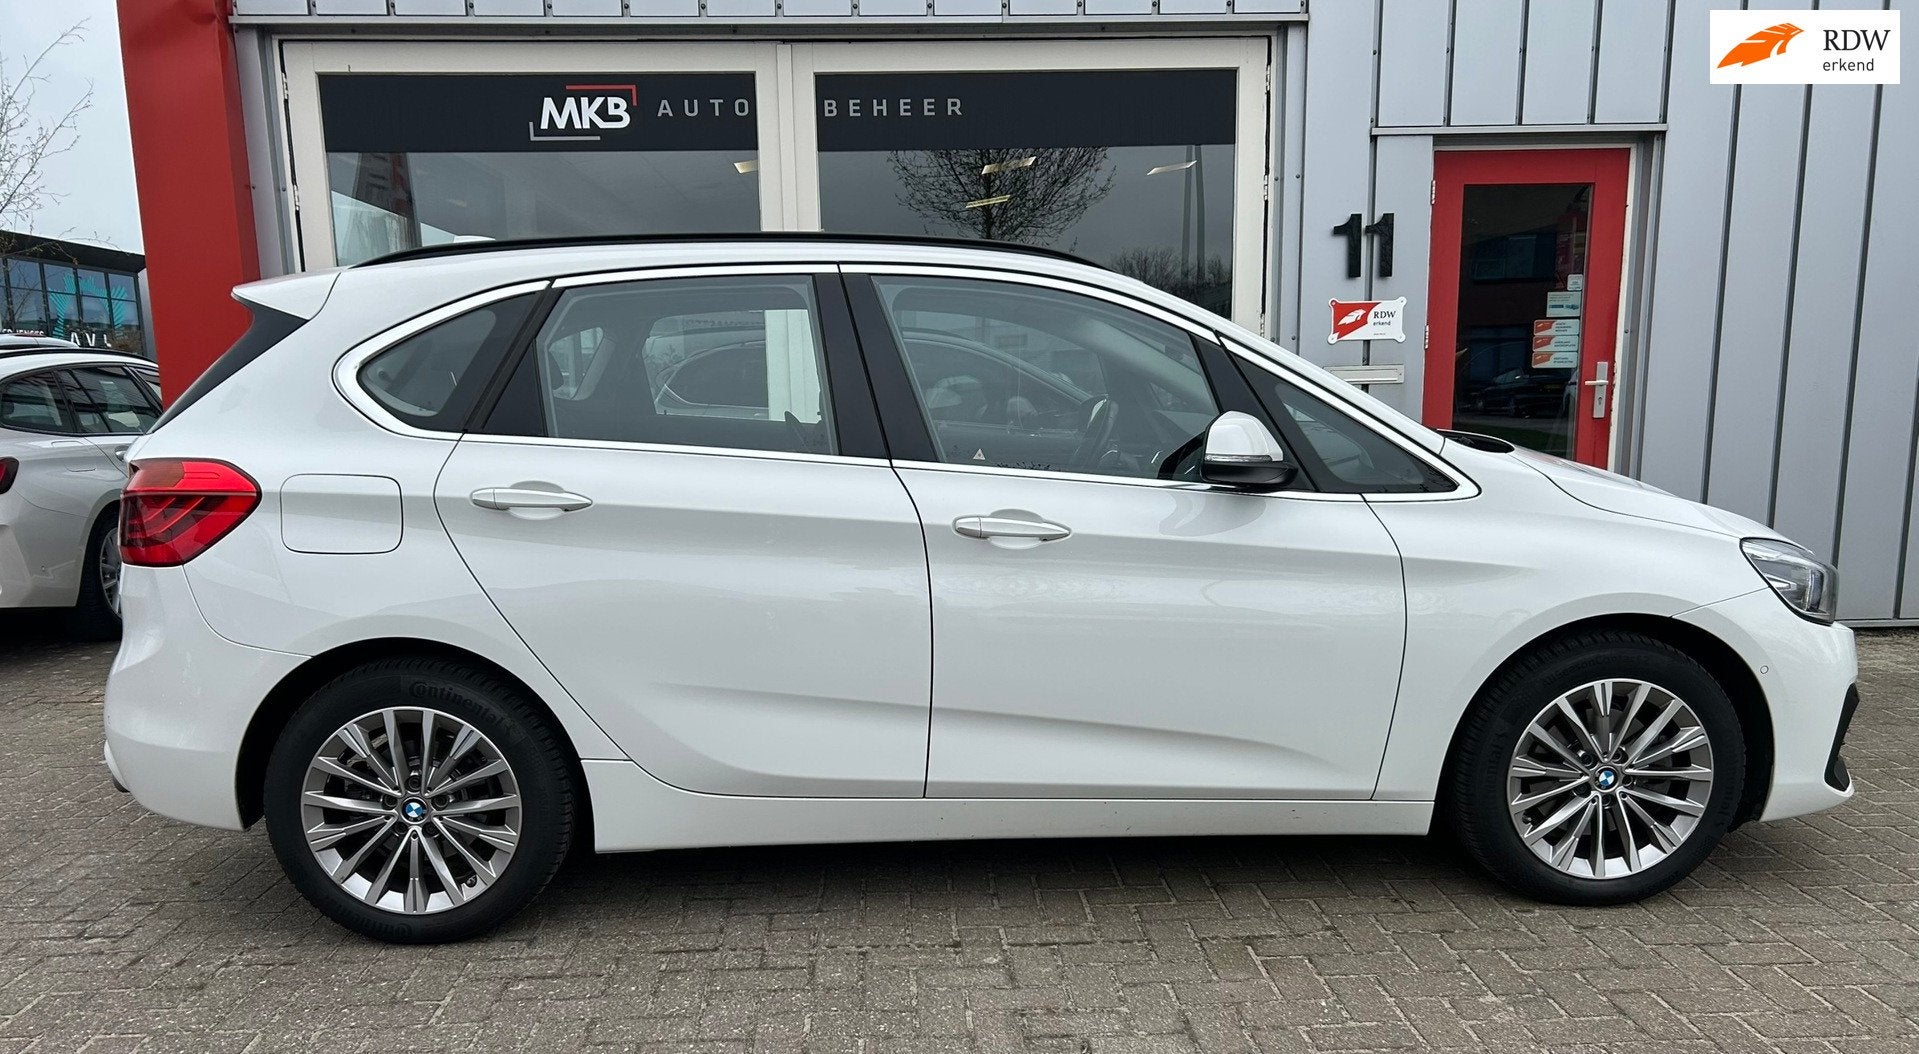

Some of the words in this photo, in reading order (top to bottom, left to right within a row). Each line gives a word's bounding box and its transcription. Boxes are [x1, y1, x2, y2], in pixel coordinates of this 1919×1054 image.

[540, 96, 631, 130] MKB
[657, 98, 749, 117] AUTO
[824, 98, 963, 117] BEHEER
[1333, 213, 1395, 278] 11
[1373, 310, 1396, 319] RDW
